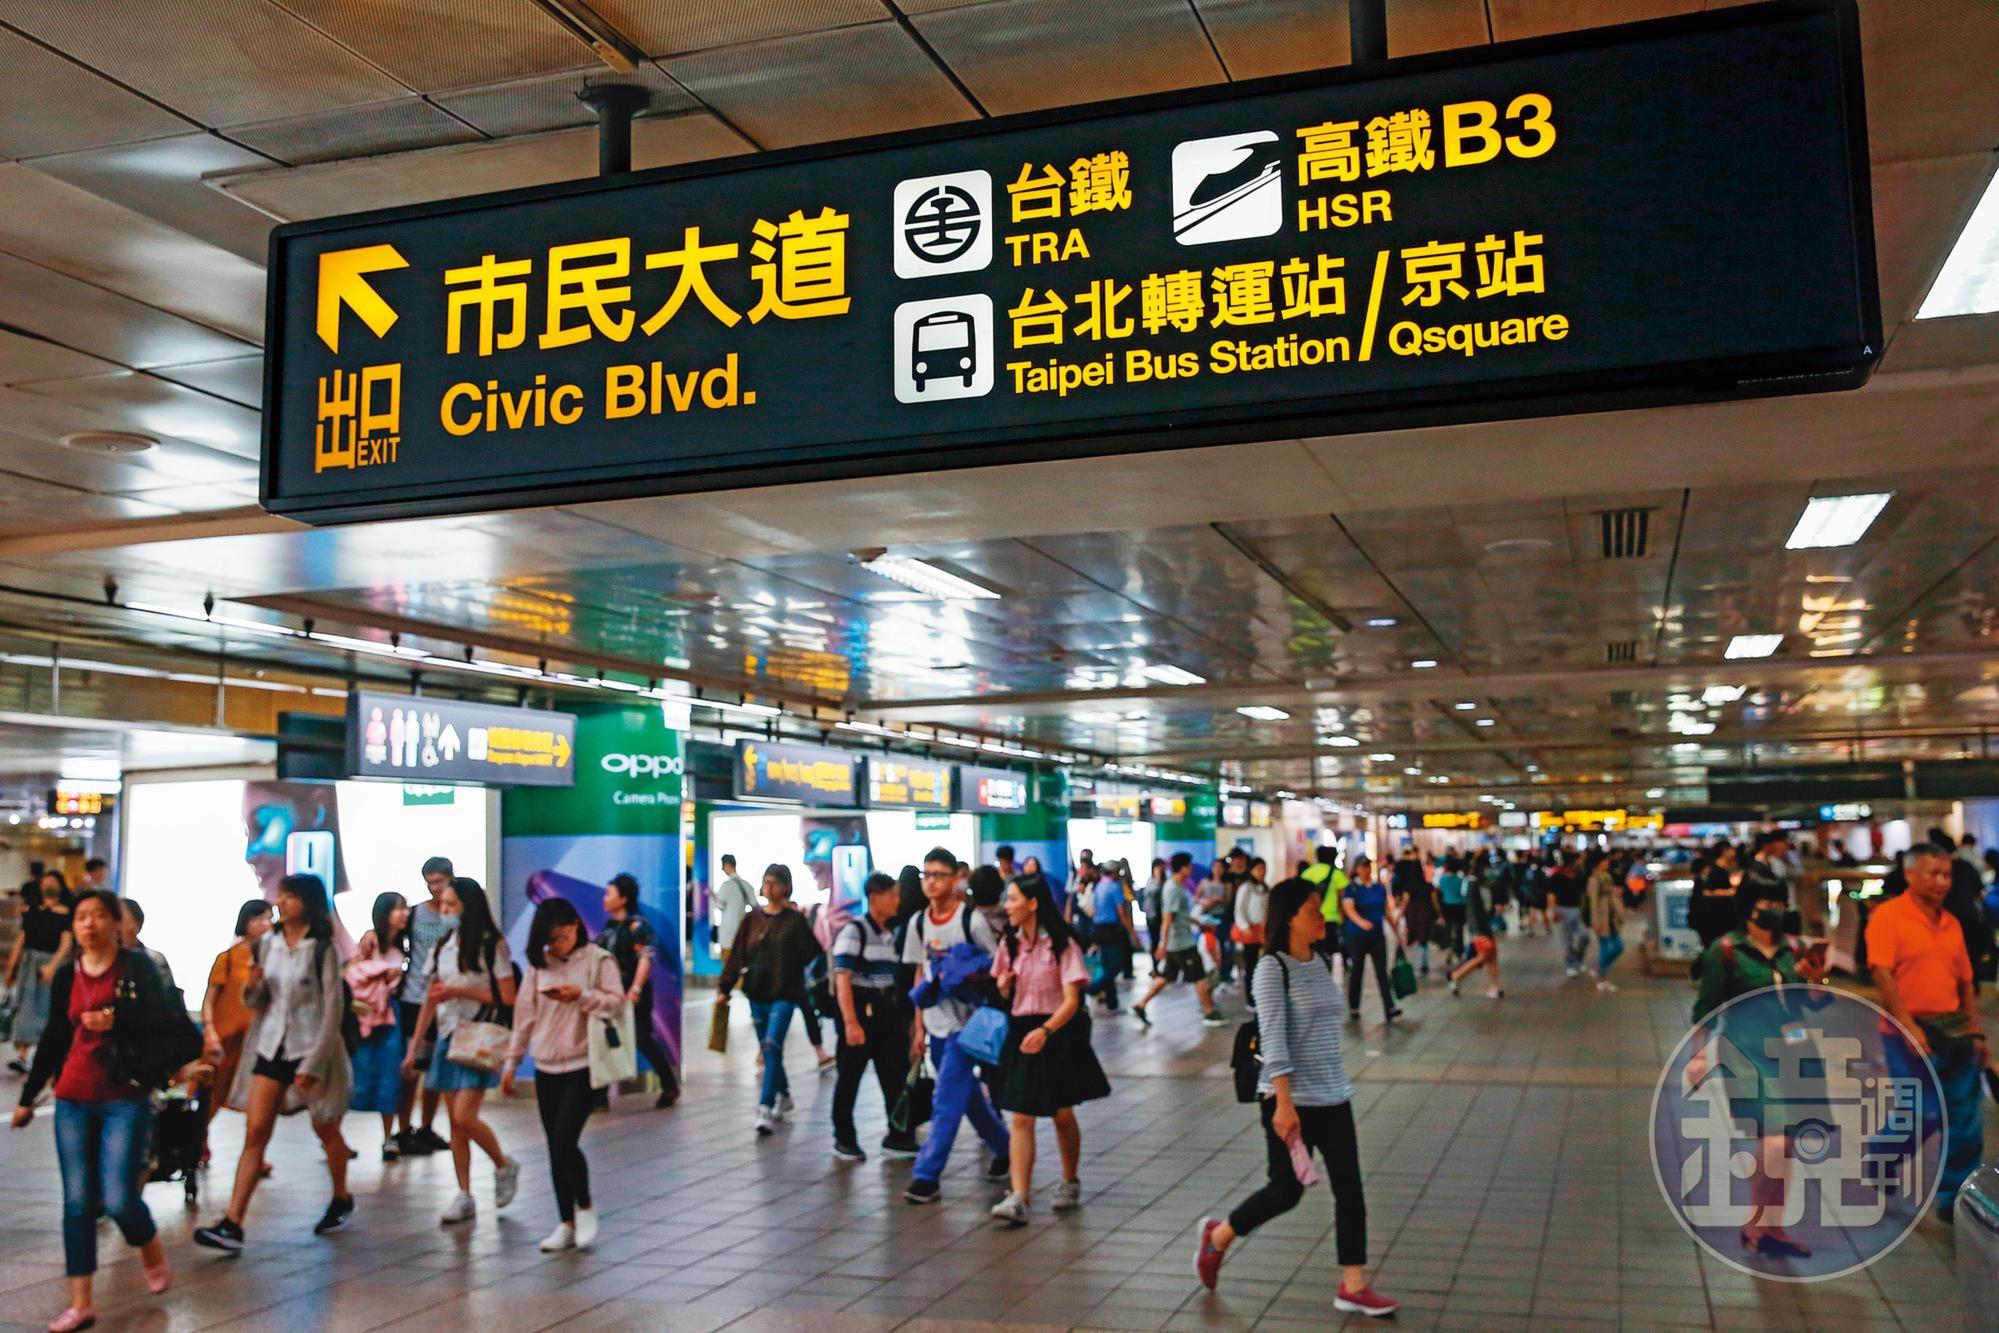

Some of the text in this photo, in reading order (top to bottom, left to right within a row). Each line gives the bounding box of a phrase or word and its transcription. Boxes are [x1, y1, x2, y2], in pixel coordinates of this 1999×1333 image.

[1005, 150, 1133, 224] 台鐵
[1298, 190, 1393, 232] HSR
[440, 206, 852, 357] 市民大道
[1006, 228, 1091, 267] TRA
[440, 352, 757, 437] Civic Blvd.
[1007, 313, 1570, 397] Taipei Bus Station Qsquare
[314, 363, 402, 474] 出口
[356, 437, 401, 467] EXIT
